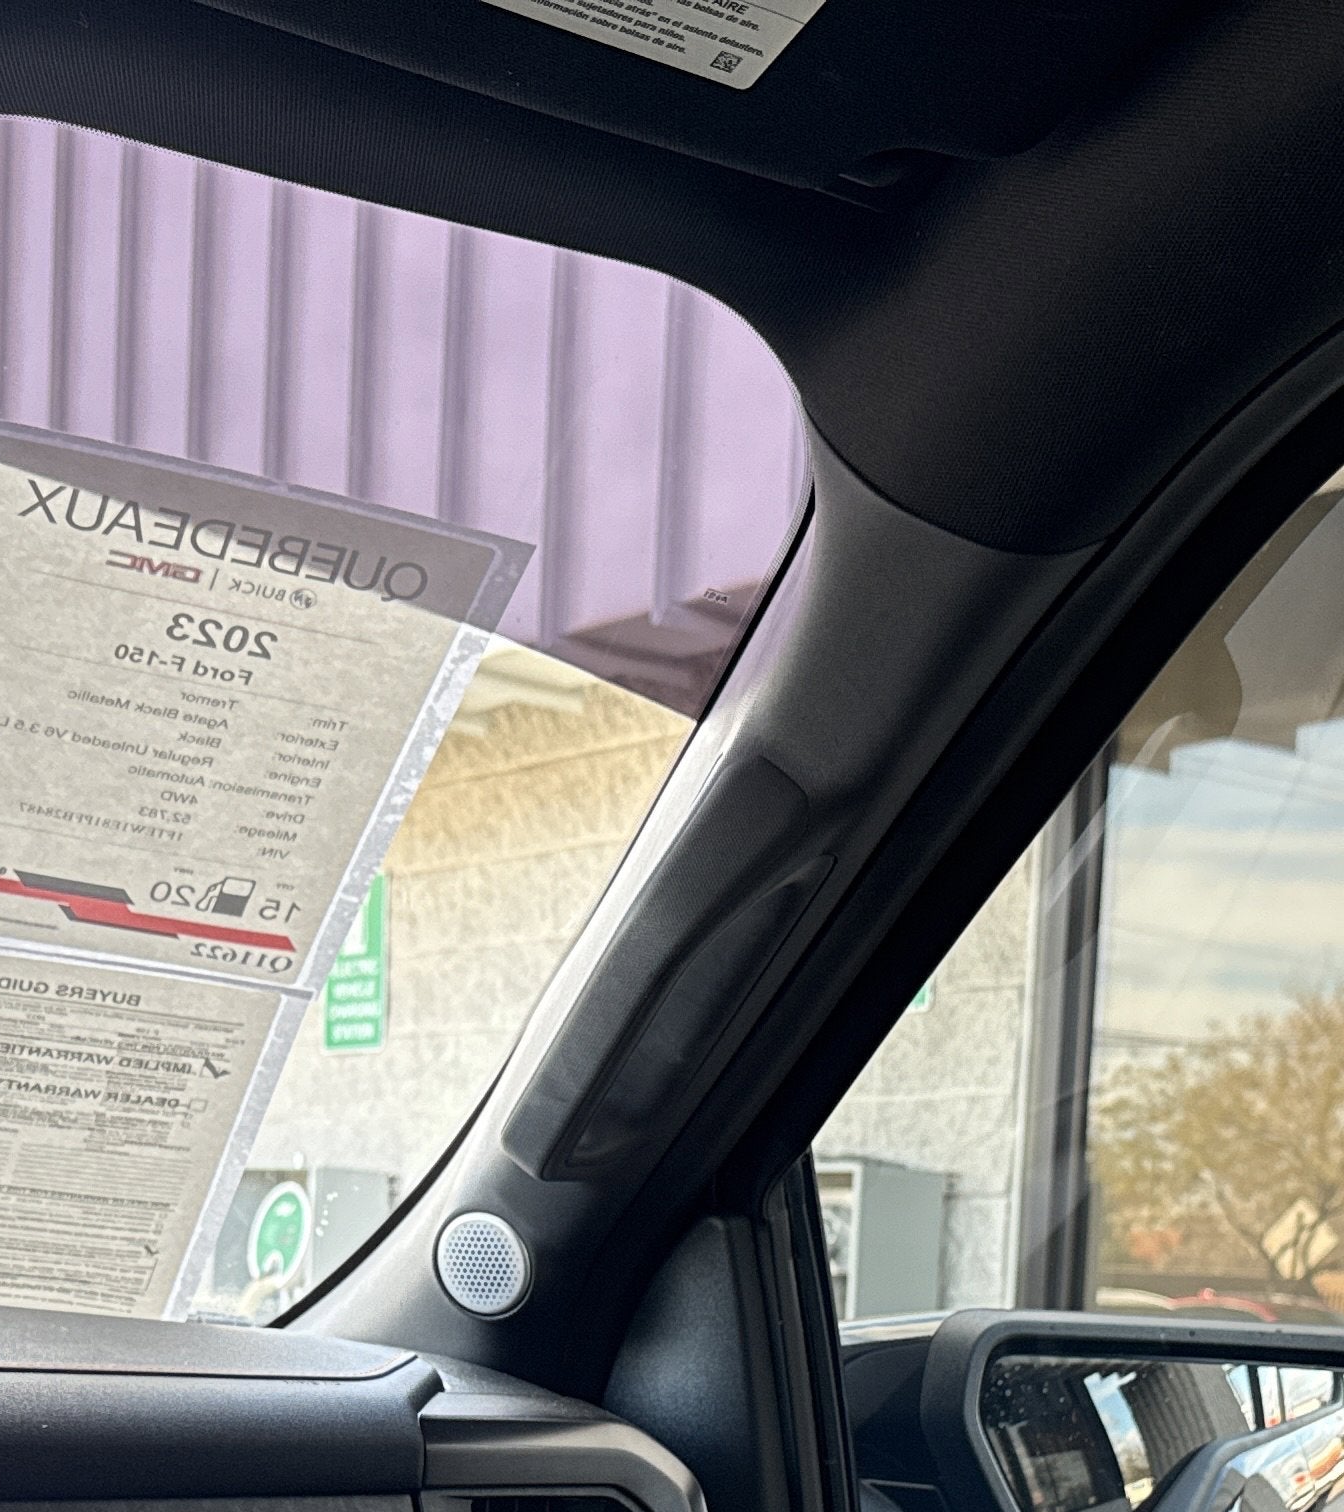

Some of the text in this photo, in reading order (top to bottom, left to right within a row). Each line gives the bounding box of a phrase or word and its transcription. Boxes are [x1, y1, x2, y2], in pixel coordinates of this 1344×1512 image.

[576, 1, 634, 24] sujetadores
[634, 19, 657, 31] para
[658, 15, 672, 24] en
[692, 2, 724, 18] bolsas
[726, 14, 739, 24] de
[590, 16, 618, 30] sobre
[618, 26, 651, 42] bolsas
[652, 36, 665, 46] de
